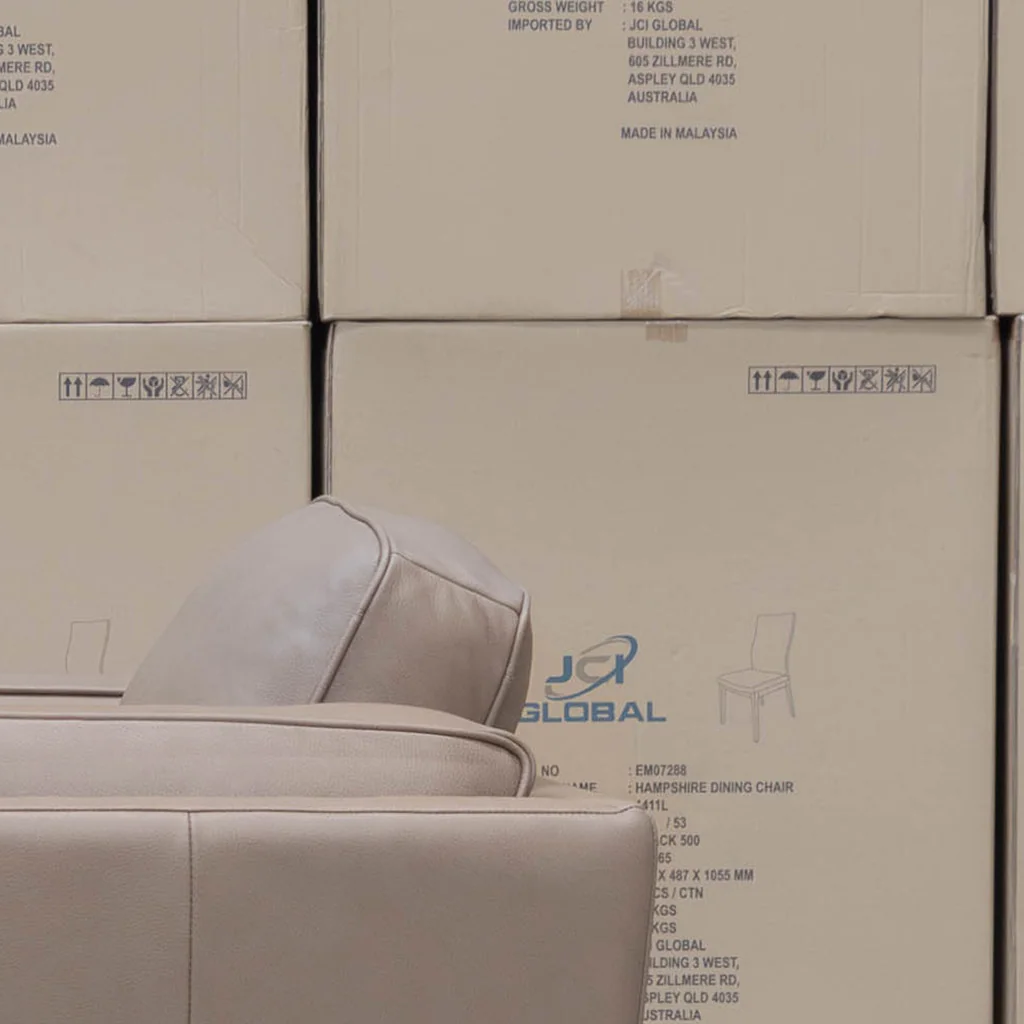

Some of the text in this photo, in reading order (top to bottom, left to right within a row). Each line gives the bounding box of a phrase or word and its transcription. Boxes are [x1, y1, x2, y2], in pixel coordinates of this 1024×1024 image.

[508, 1, 551, 13] GROSS
[556, 1, 604, 13] WEIGHT
[630, 1, 644, 13] 16
[648, 1, 673, 13] KGS
[508, 19, 572, 31] IMPORTED
[576, 19, 592, 31] BY
[629, 19, 648, 31] JCI
[652, 19, 702, 31] GLOBAL
[628, 37, 736, 50] BUILDING 3 WEST,
[8, 44, 13, 56] 3
[17, 44, 54, 56] WEST,
[629, 55, 736, 67] 605 ZILLMERE RD,
[35, 62, 55, 74] RD,
[628, 73, 735, 85] ASPLEY QLD 4035
[27, 80, 54, 92] 4035
[628, 91, 697, 103] AUSTRALIA
[621, 127, 737, 139] MADE IN MALAYSIA
[518, 701, 666, 723] GLOBAL
[541, 765, 559, 777] NO
[636, 765, 686, 776] EM07288
[636, 782, 707, 793] HAMPSHIRE
[711, 782, 752, 793] DINING
[756, 782, 793, 793] CHAIR
[635, 800, 668, 812] 411L
[674, 817, 686, 829] 53
[680, 835, 700, 846] 500
[658, 870, 754, 881] X 487 X 1055 MM
[679, 887, 703, 899] CTN
[656, 939, 706, 951] GLOBAL
[649, 956, 739, 969] ILDING 3 WEST,
[656, 974, 716, 987] ZILLMERE
[720, 974, 740, 987] RD,
[644, 992, 739, 1003] SPLEY QLD 4035
[643, 1009, 701, 1020] USTRALIA
